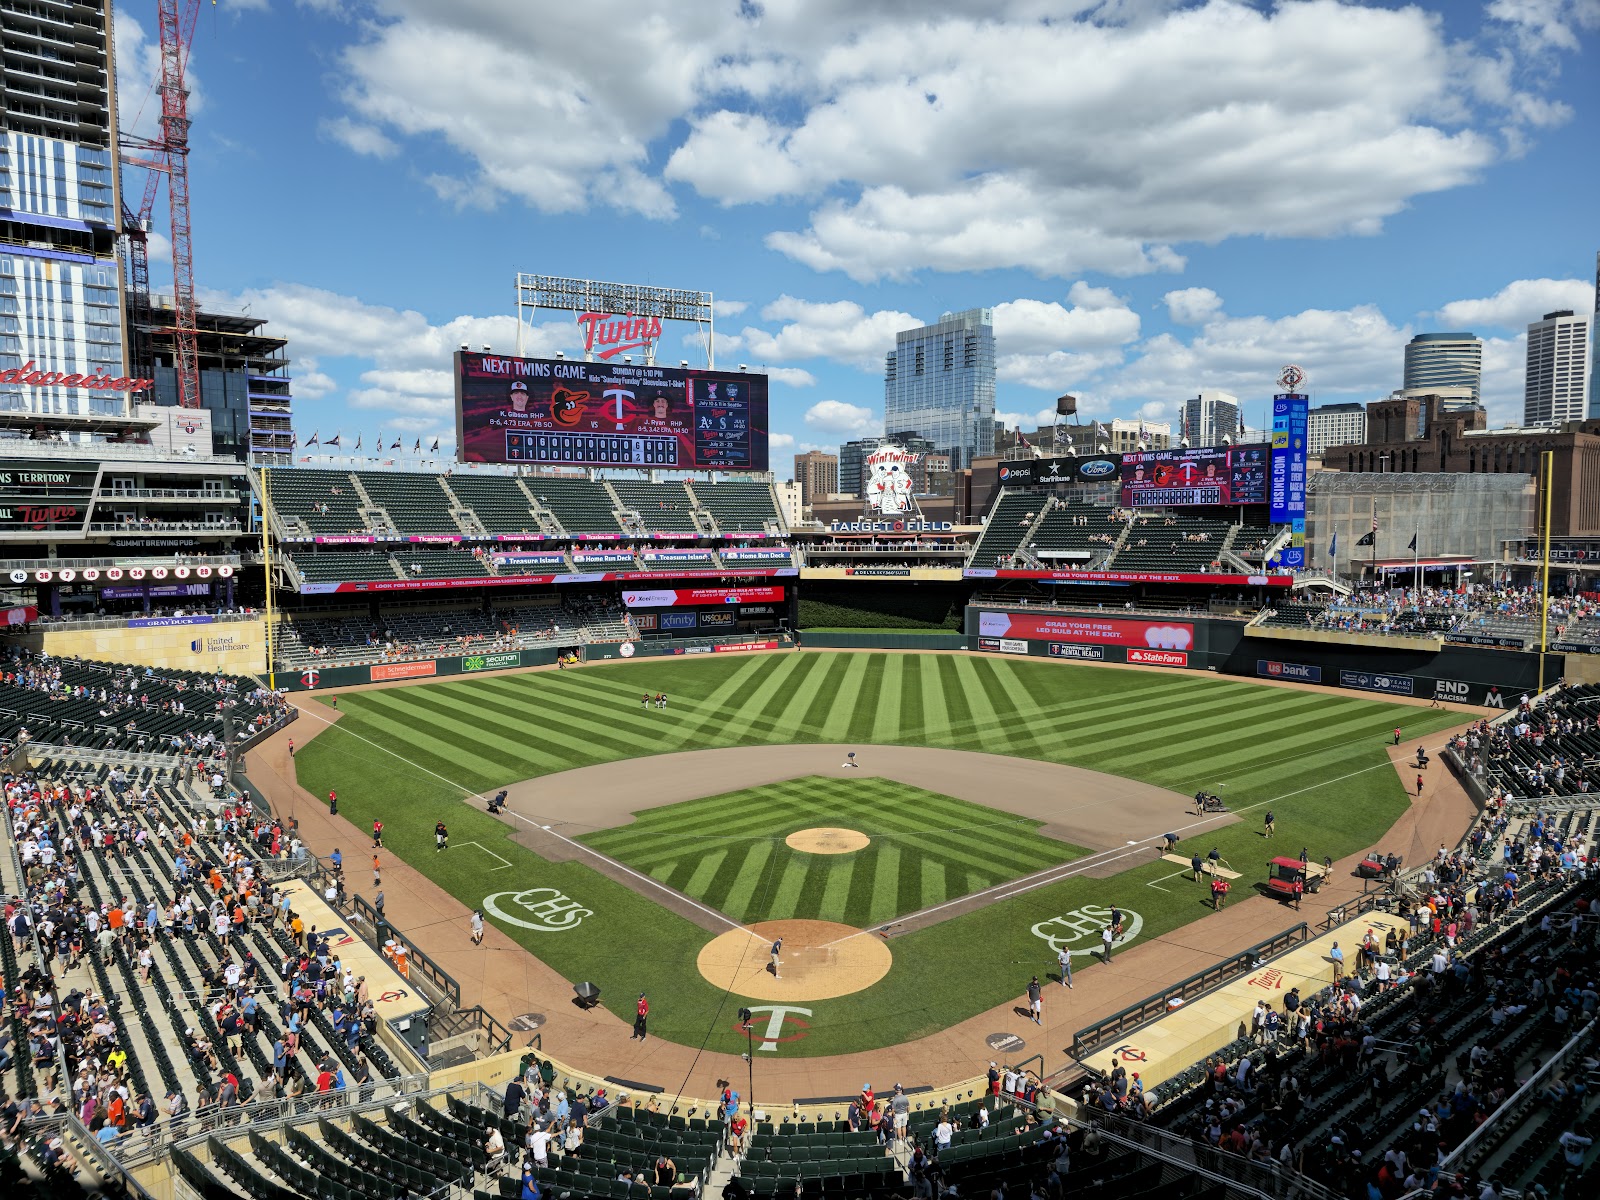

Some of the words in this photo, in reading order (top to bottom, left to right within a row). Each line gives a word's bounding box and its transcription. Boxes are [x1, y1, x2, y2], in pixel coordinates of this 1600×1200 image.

[578, 311, 662, 351] Twins
[482, 358, 512, 374] NEXT
[513, 361, 550, 377] TWINS
[554, 364, 586, 380] GAME
[612, 367, 636, 376] SUNDAY
[643, 370, 654, 378] 1:10
[588, 374, 600, 383] Kids
[668, 380, 685, 388] T-Shirt
[508, 411, 528, 419] Gibson
[528, 438, 532, 446] 0
[540, 438, 545, 446] 6
[552, 438, 557, 446] 0
[565, 438, 569, 447] 0
[577, 439, 582, 447] 0
[589, 440, 594, 448] 0
[601, 440, 605, 448] 0
[612, 440, 617, 448] 0
[624, 441, 628, 449] 0
[636, 441, 640, 449] 6
[647, 442, 651, 450] 6
[658, 443, 662, 451] 0
[669, 443, 674, 451] 3
[529, 450, 532, 458] 1
[541, 450, 546, 458] 0
[553, 450, 558, 459] 0
[565, 451, 570, 459] 0
[577, 451, 582, 459] 0
[590, 452, 593, 460] 1
[601, 452, 606, 460] 0
[613, 452, 617, 460] 0
[636, 453, 640, 461] 2
[658, 454, 662, 462] 0
[669, 454, 674, 462] 8
[867, 452, 888, 465] Win!
[889, 451, 919, 464] Twins!
[1156, 452, 1172, 460] GAME
[1010, 468, 1031, 478] pepsi
[1086, 463, 1108, 474] Ford
[18, 473, 71, 483] TERRITORY
[1273, 456, 1286, 508] CHSINC.COM
[18, 506, 76, 523] Twins
[831, 522, 890, 531] TARGET
[907, 522, 952, 531] FIELD
[1528, 550, 1573, 558] TAGET
[186, 584, 209, 596] WIN!
[663, 615, 694, 626] xfinity
[207, 643, 249, 652] Healthcare
[1499, 638, 1523, 647] Corona
[388, 664, 432, 672] Schneiderman's
[1269, 664, 1280, 672] us
[1283, 663, 1309, 676] bank
[1374, 677, 1390, 687] 50
[1436, 680, 1469, 694] END
[1438, 694, 1467, 702] RACISM
[513, 888, 594, 925] CHS
[1248, 969, 1282, 990] Twins
